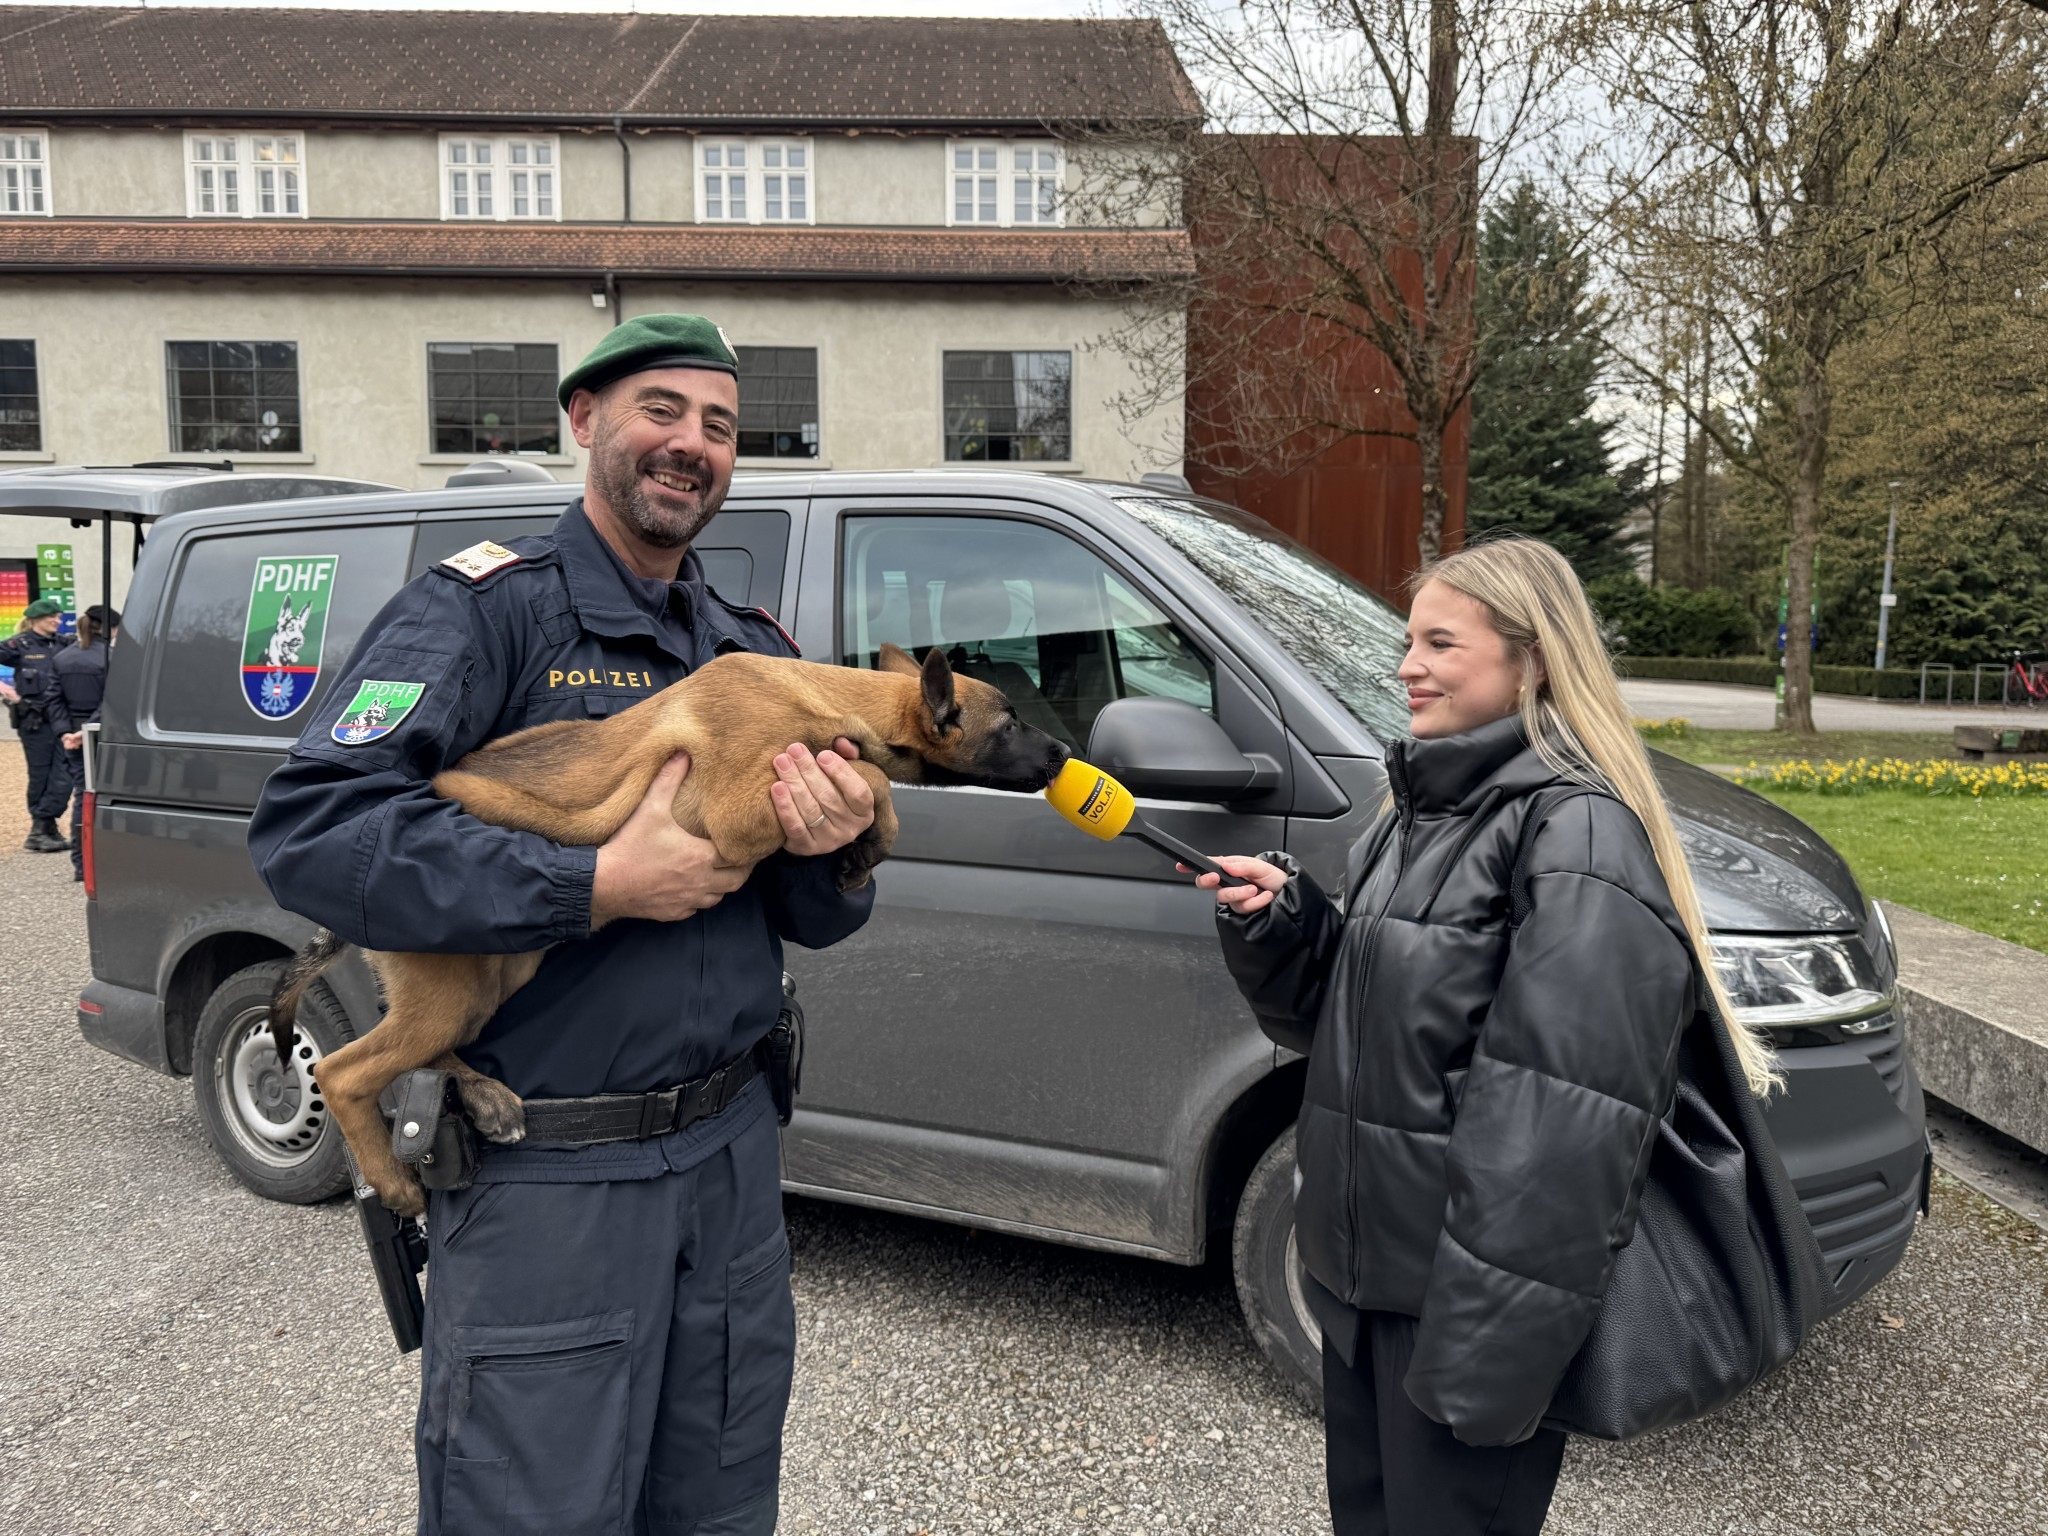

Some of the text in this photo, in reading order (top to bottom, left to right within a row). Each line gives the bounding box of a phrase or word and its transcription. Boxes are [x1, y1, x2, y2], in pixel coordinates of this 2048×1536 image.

[257, 562, 332, 592] PDHF
[549, 668, 652, 688] POLIZEI
[363, 683, 419, 699] PDHF
[1089, 784, 1115, 819] VOL.AT
